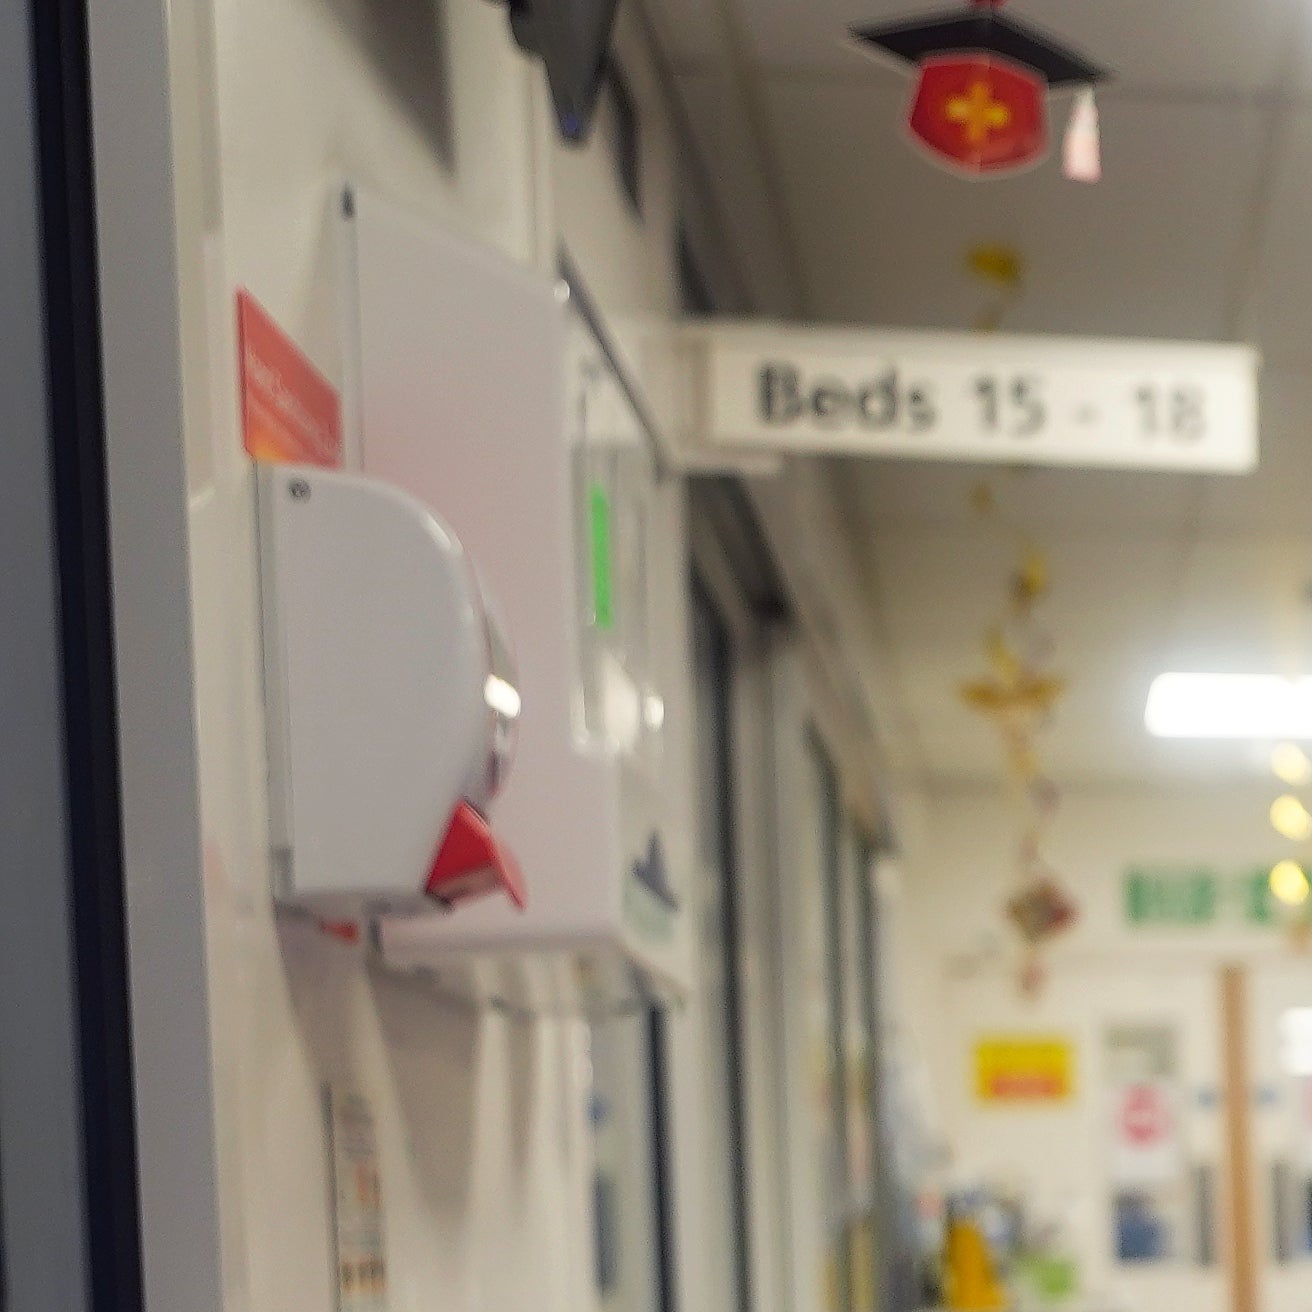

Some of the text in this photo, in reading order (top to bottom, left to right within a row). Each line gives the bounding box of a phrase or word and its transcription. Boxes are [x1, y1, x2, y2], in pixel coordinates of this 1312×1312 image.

[758, 361, 939, 432] Beds
[974, 372, 1048, 438] 15
[1134, 378, 1207, 443] 18
